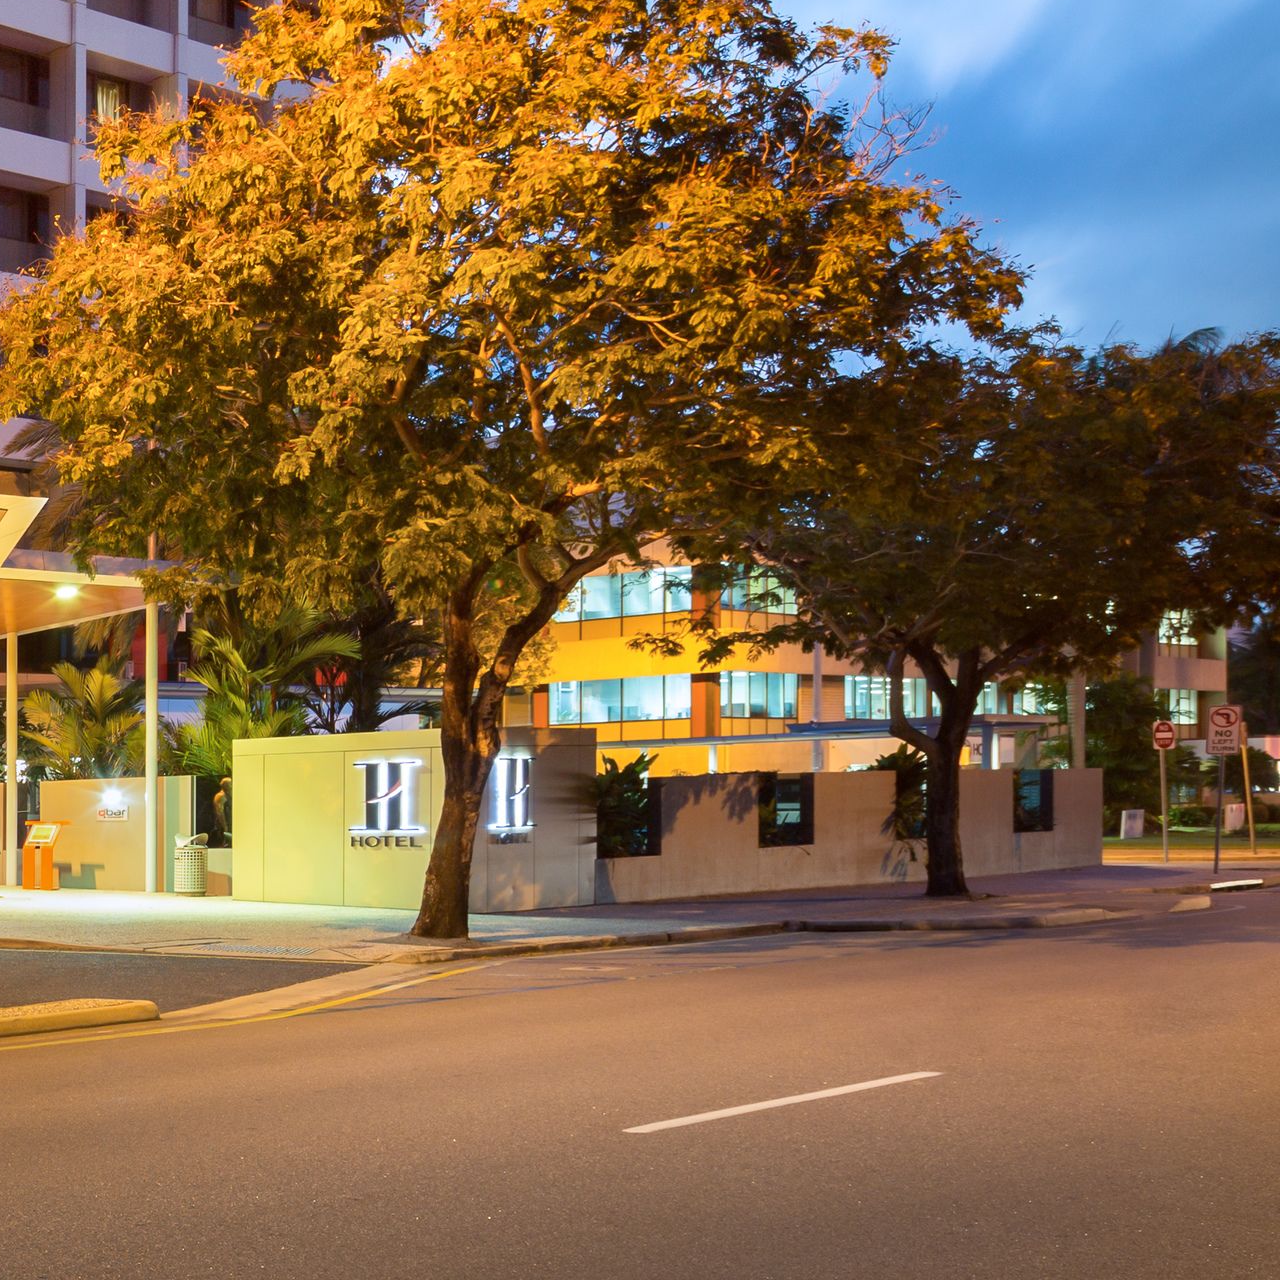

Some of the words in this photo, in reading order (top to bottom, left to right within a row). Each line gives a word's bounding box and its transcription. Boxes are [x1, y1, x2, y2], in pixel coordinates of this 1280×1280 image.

[348, 760, 423, 832] H
[98, 808, 126, 819] qbar
[351, 835, 423, 848] HOTEL
